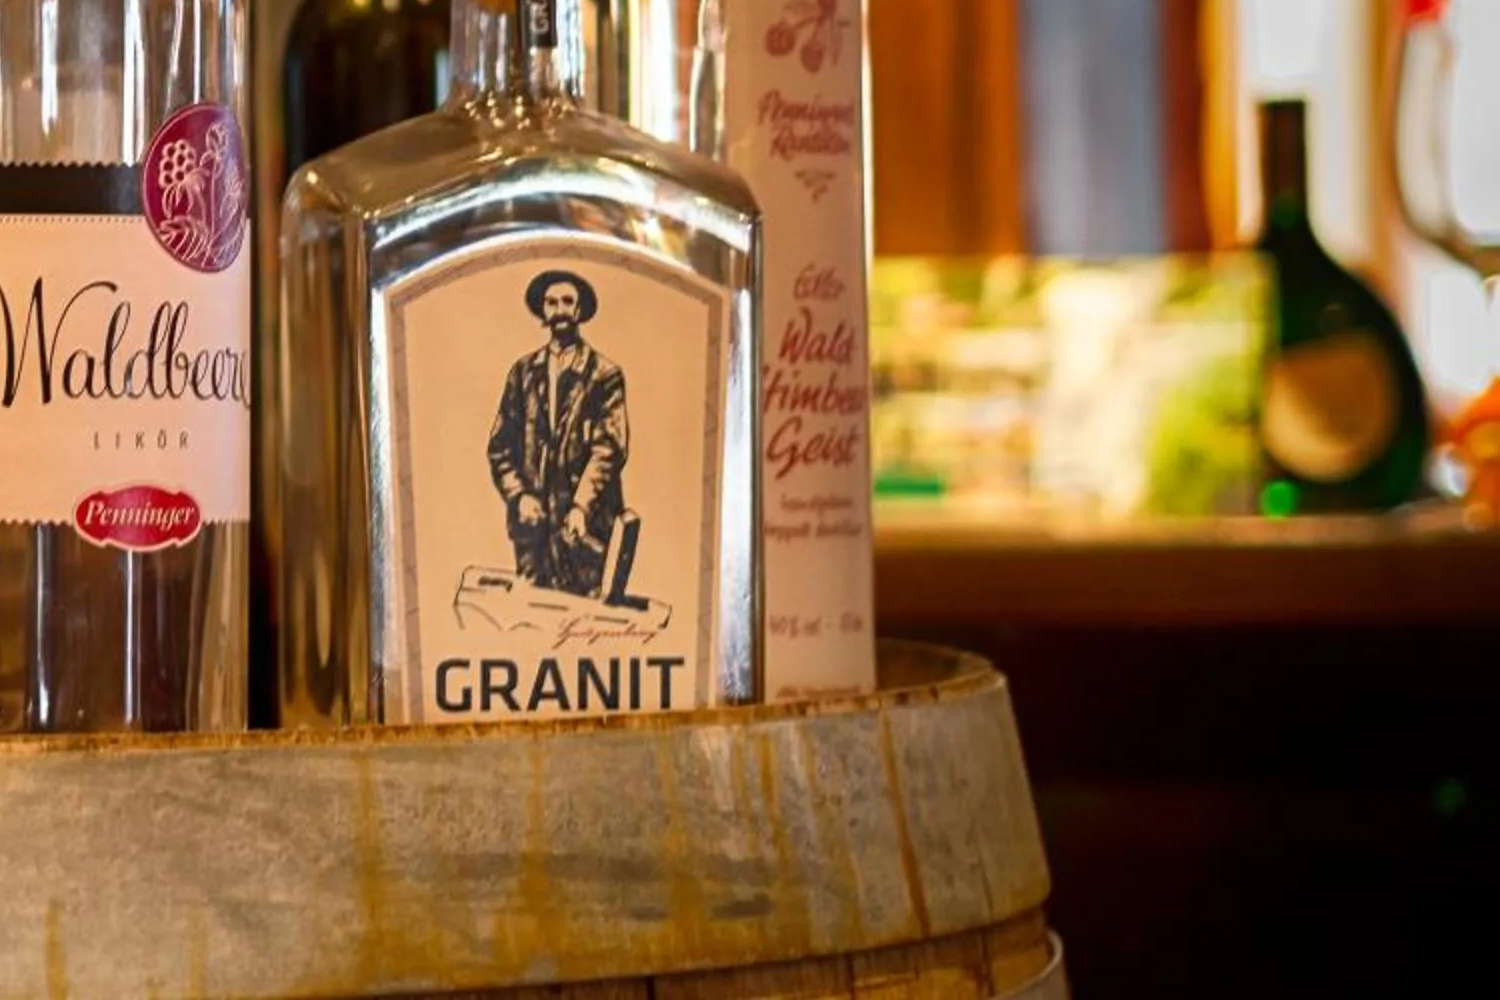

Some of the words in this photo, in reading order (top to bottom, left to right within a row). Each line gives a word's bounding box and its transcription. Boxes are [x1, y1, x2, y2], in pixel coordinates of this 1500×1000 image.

[93, 430, 189, 450] LIKÖR
[766, 416, 861, 481] Geist
[84, 500, 196, 532] Penninger
[435, 656, 685, 714] GRANIT
